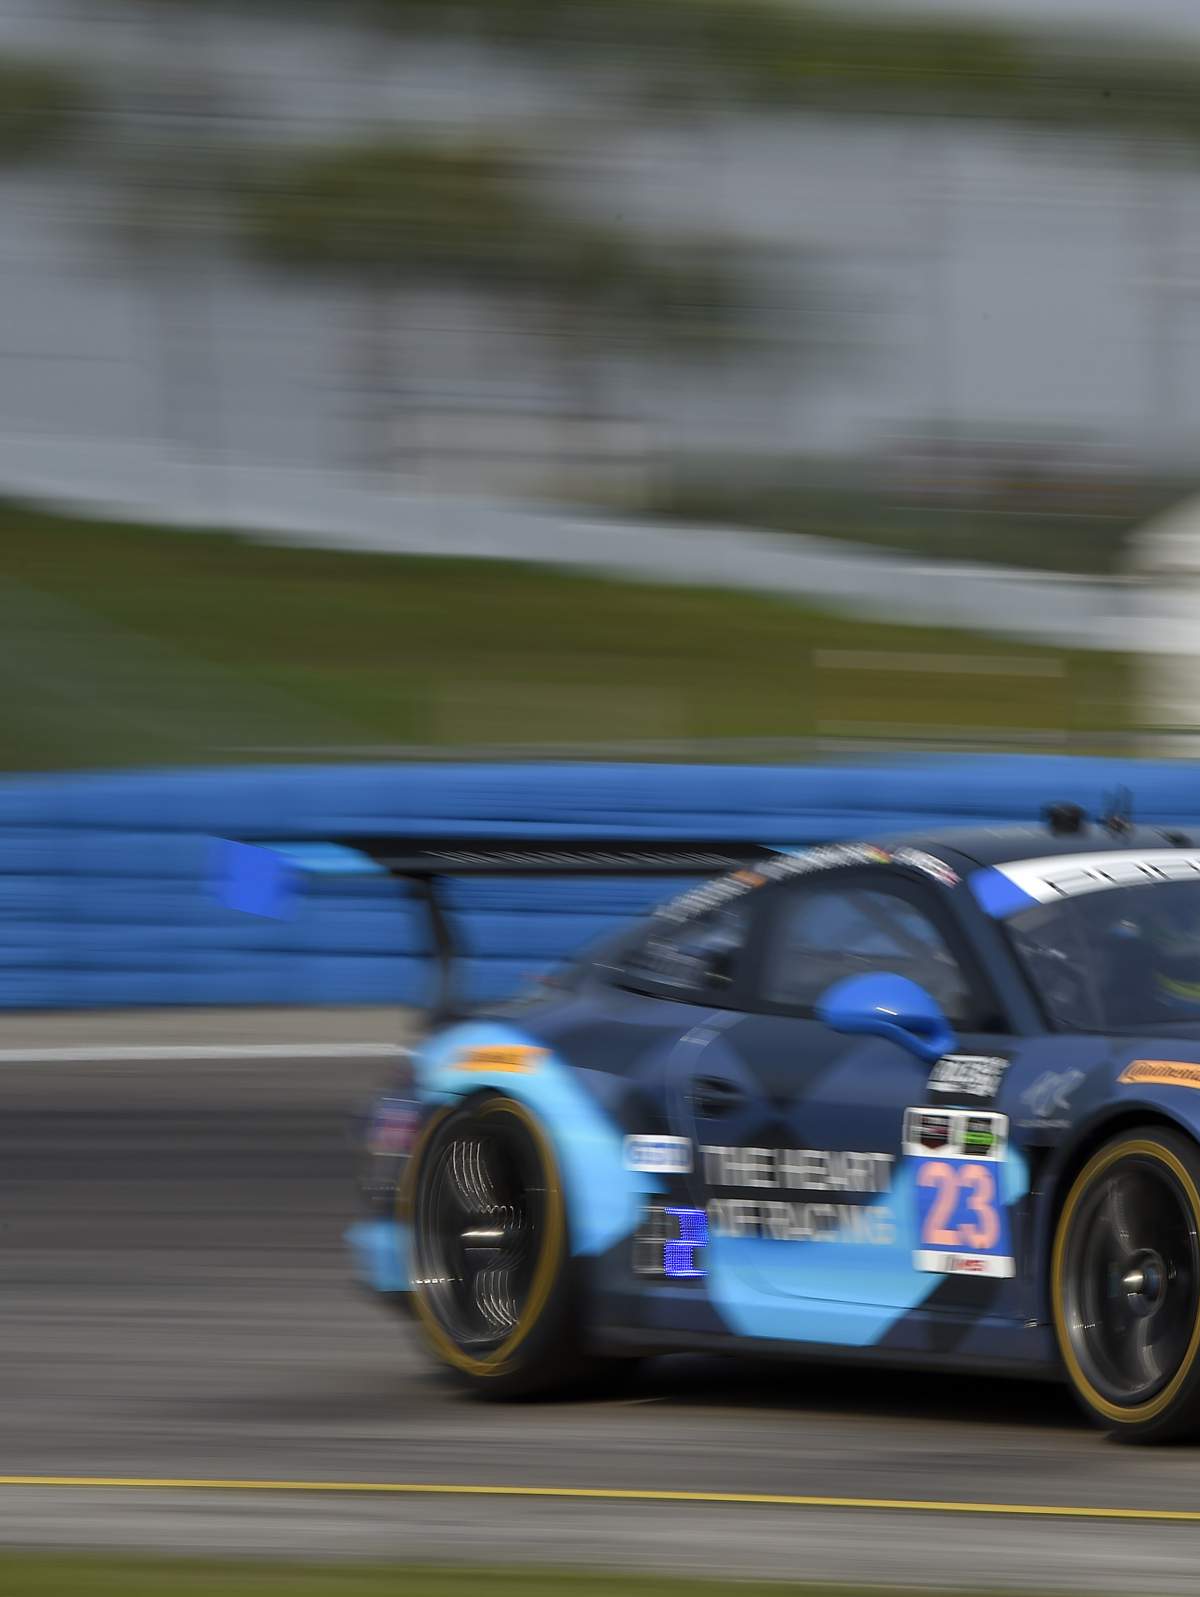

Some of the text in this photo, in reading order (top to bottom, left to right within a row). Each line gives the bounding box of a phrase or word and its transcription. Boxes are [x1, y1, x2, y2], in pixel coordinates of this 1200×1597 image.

[700, 1145, 777, 1187] THE
[777, 1149, 896, 1193] HEART
[917, 1161, 999, 1249] 23
